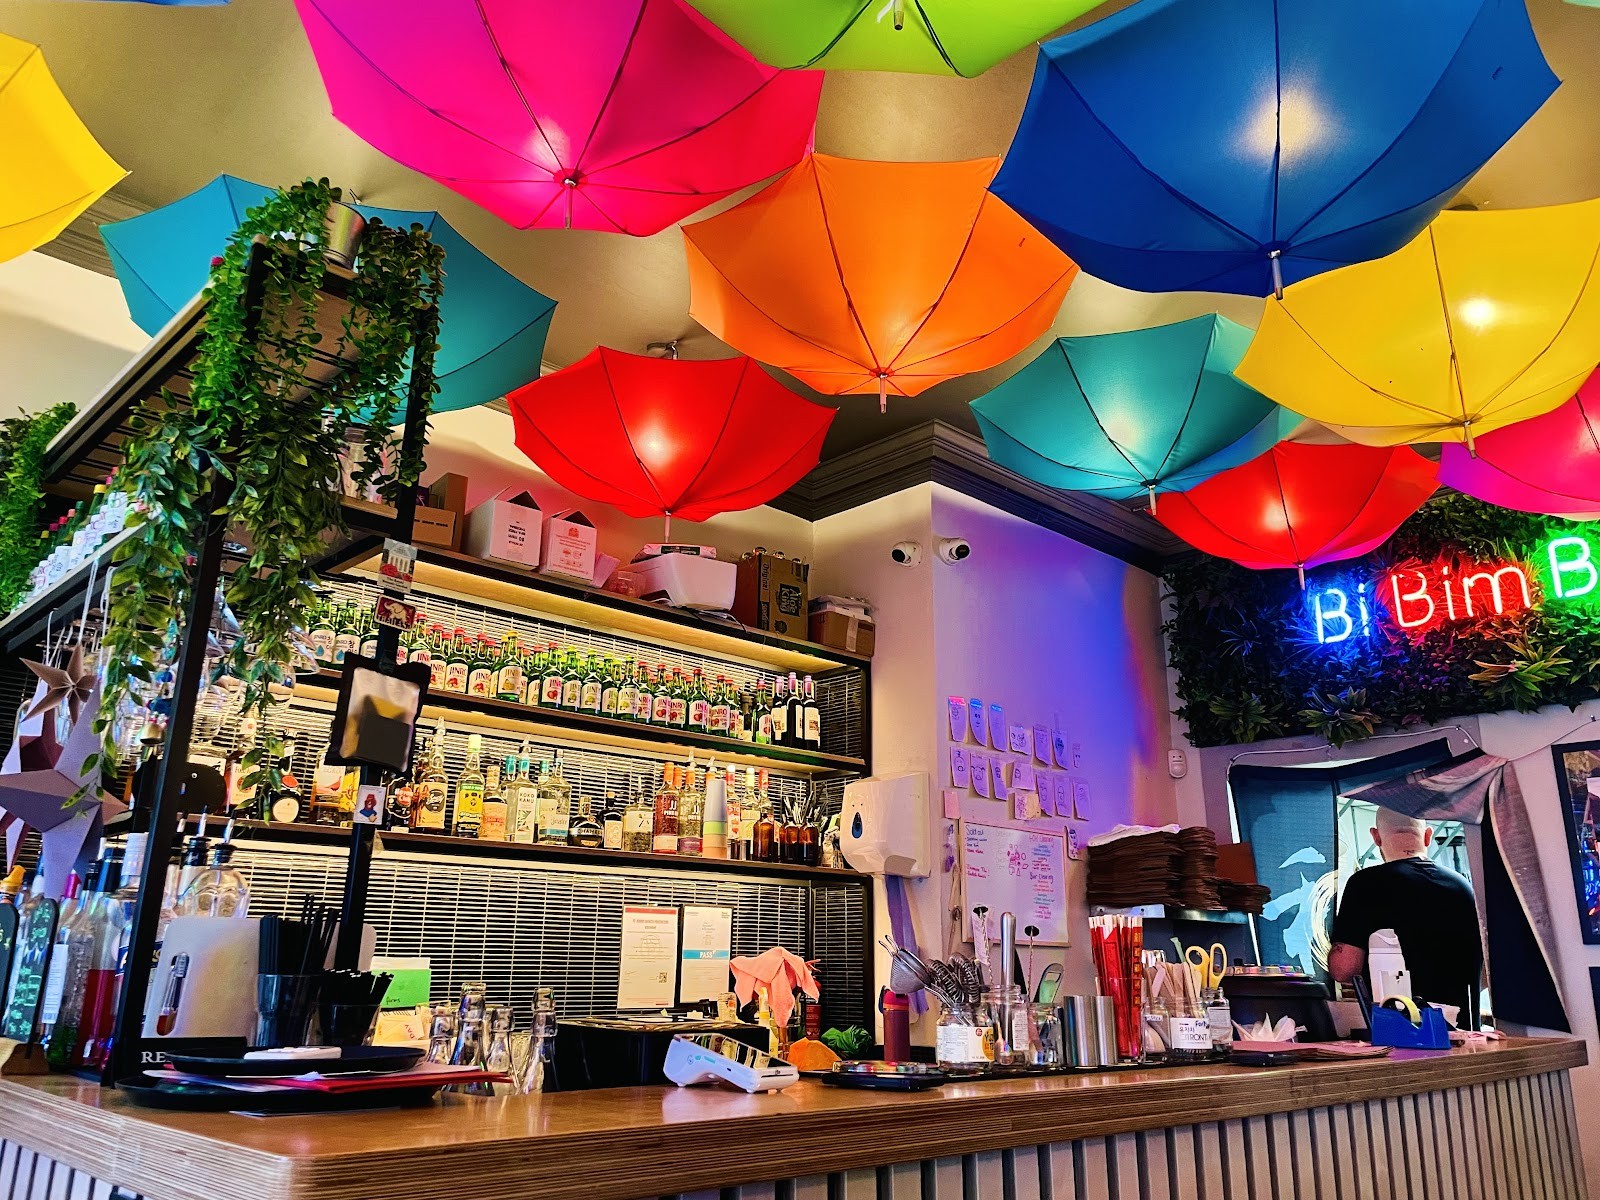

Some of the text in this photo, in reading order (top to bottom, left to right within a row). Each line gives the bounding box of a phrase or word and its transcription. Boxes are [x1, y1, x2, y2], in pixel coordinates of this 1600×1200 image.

[780, 587, 790, 612] King
[789, 587, 799, 614] Aloe
[1314, 582, 1370, 645] Bi
[1390, 565, 1531, 628] Bim
[699, 951, 713, 959] PASS
[140, 1051, 171, 1064] RE
